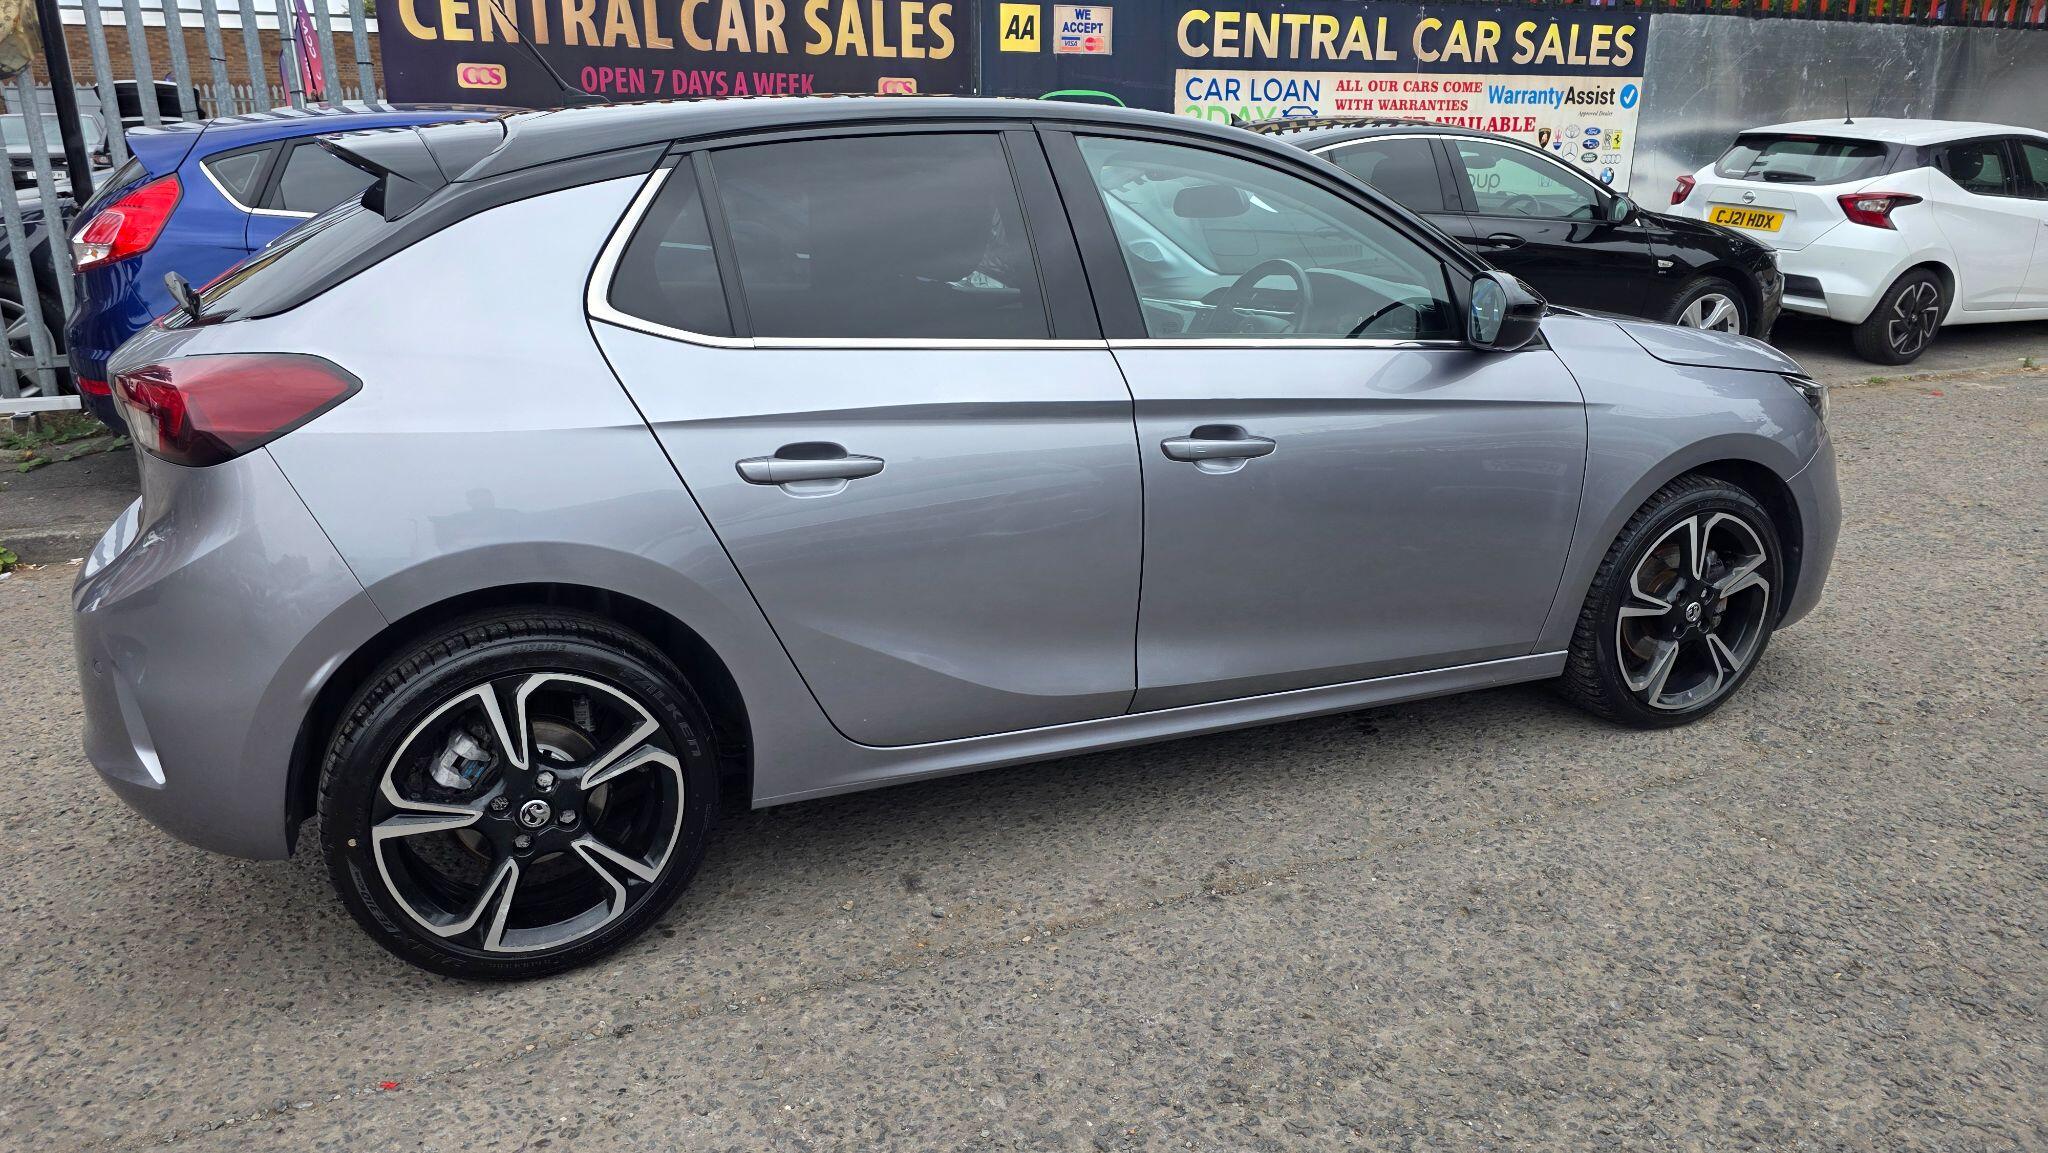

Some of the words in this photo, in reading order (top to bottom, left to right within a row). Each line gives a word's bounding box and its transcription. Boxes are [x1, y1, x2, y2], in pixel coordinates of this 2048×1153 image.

[1075, 9, 1091, 20] WE
[398, 0, 674, 49] CENTRAL
[680, 0, 788, 54] CAR
[804, 0, 955, 59] SALES
[1005, 15, 1034, 40] AA
[1062, 22, 1103, 33] ACCEPT
[1177, 10, 1397, 61] CENTRAL
[1412, 18, 1501, 63] CAR
[1512, 21, 1636, 67] SALES
[462, 67, 501, 85] CCS
[581, 66, 645, 94] OPEN
[652, 69, 665, 93] 7
[672, 69, 728, 95] DAYS
[734, 72, 749, 95] A
[753, 73, 814, 95] WEEK
[1185, 77, 1240, 101] CAR
[1250, 78, 1320, 101] LOAN
[1336, 80, 1363, 91] ALL
[1368, 80, 1398, 92] OUR
[1403, 81, 1439, 92] CARS
[1443, 82, 1483, 93] COME
[1335, 99, 1373, 110] WITH
[1378, 100, 1468, 111] WARRANTIES
[1436, 116, 1536, 132] VAILABLE
[1716, 210, 1746, 226] CJ21
[1746, 213, 1775, 228] HDX
